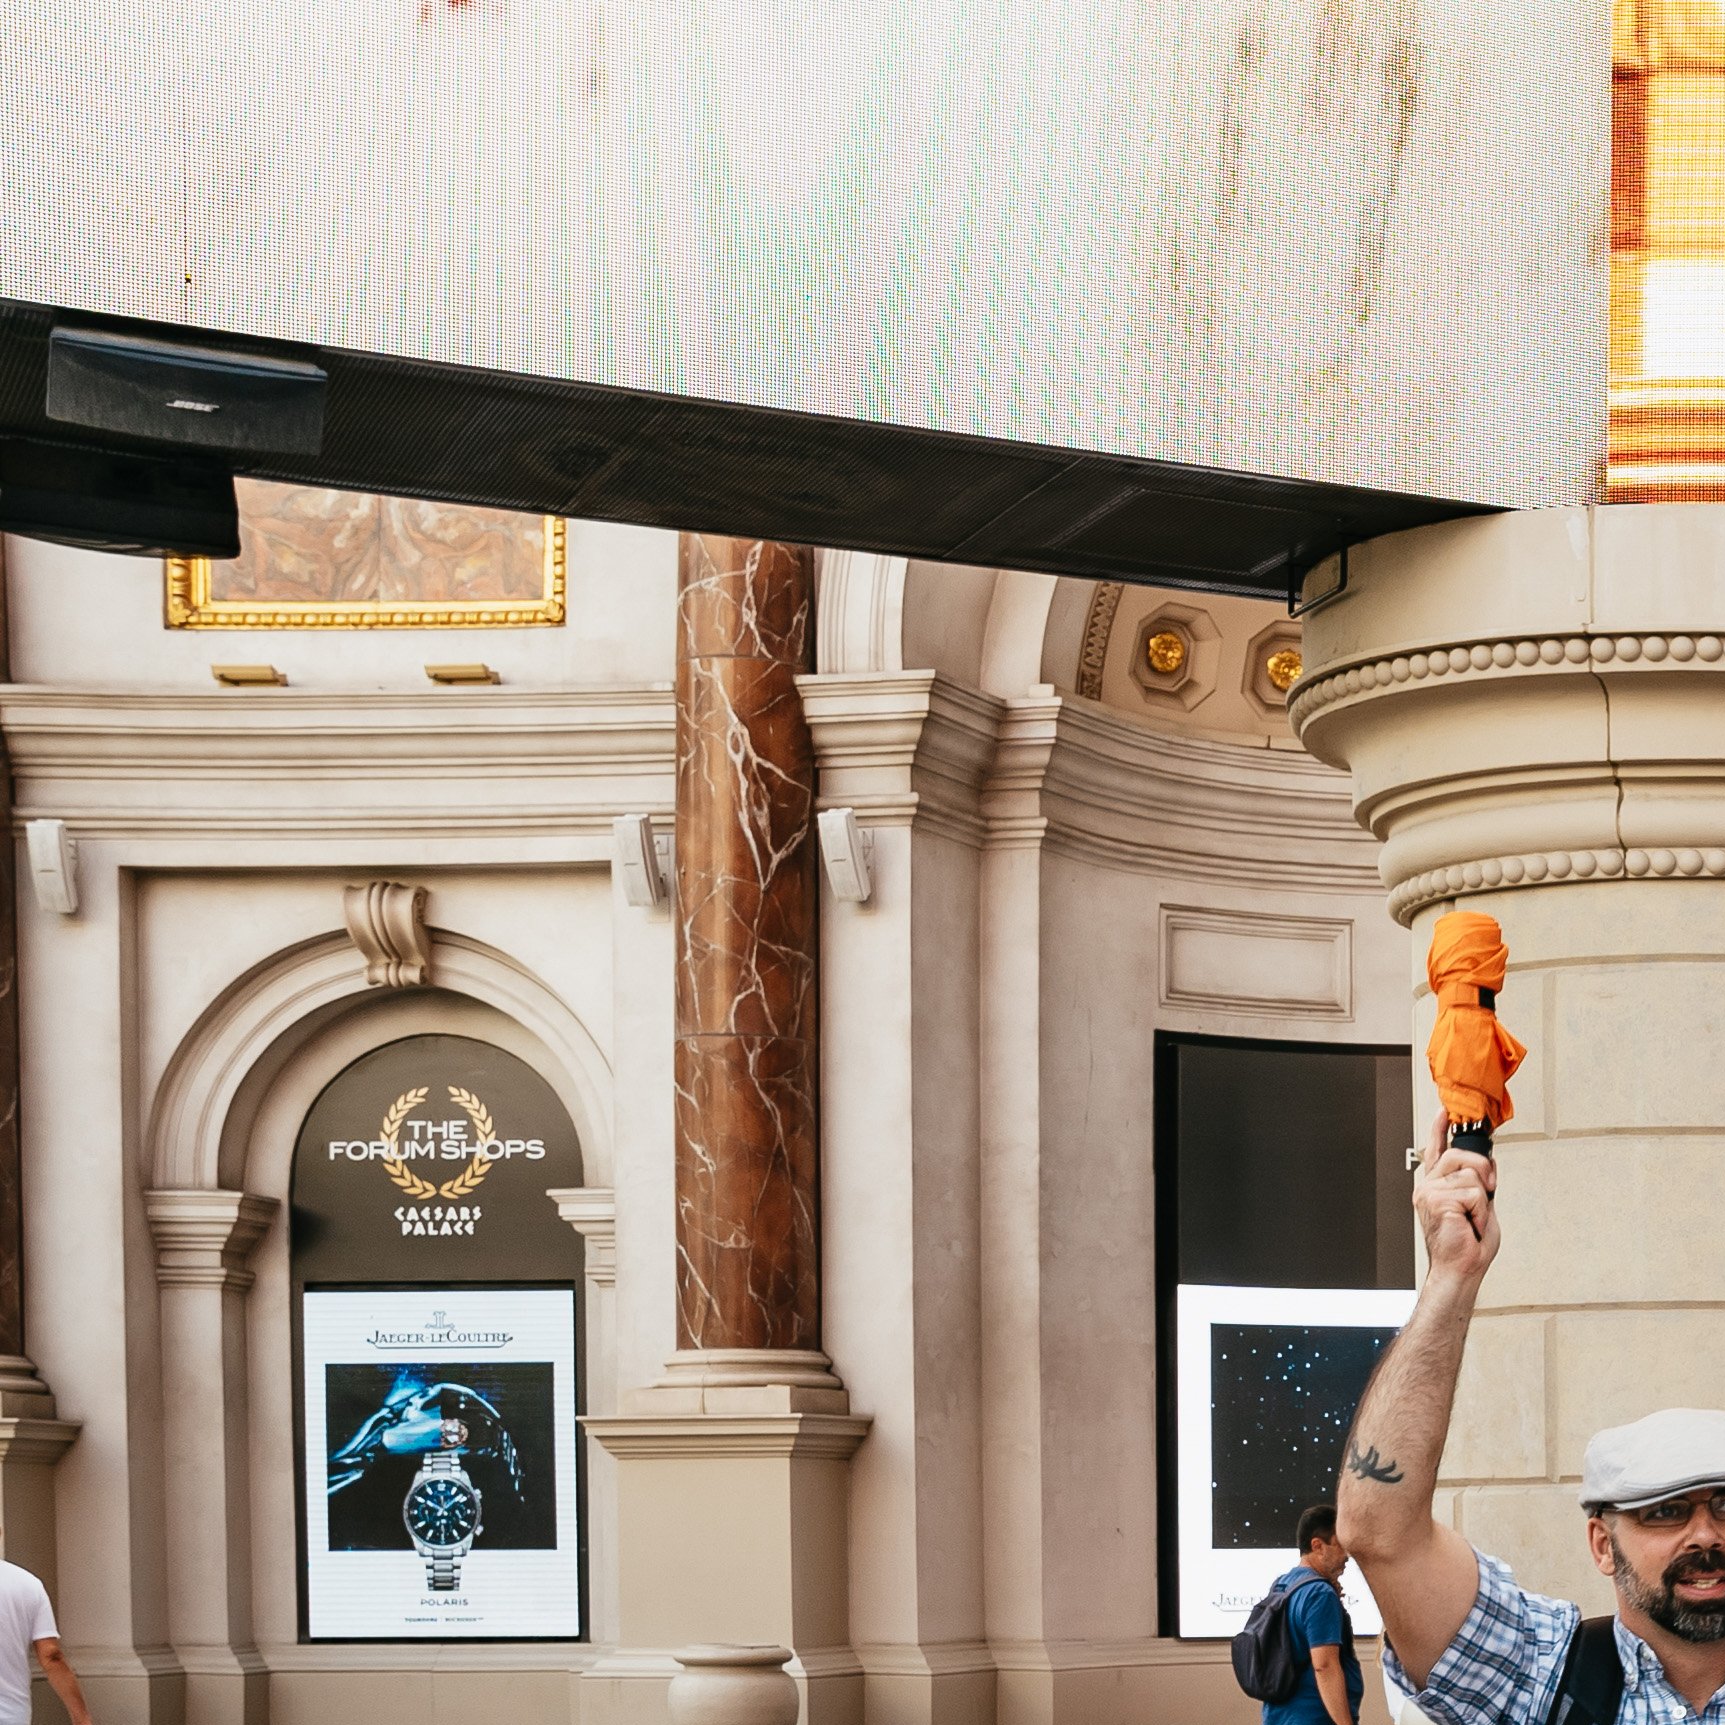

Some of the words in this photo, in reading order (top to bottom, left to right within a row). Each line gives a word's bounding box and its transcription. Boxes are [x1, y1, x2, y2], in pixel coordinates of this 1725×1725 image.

[407, 1120, 468, 1140] THE
[329, 1140, 435, 1161] FORUM
[440, 1140, 546, 1160] SHOPS
[394, 1206, 482, 1221] CAESARS
[402, 1221, 475, 1236] PALACE
